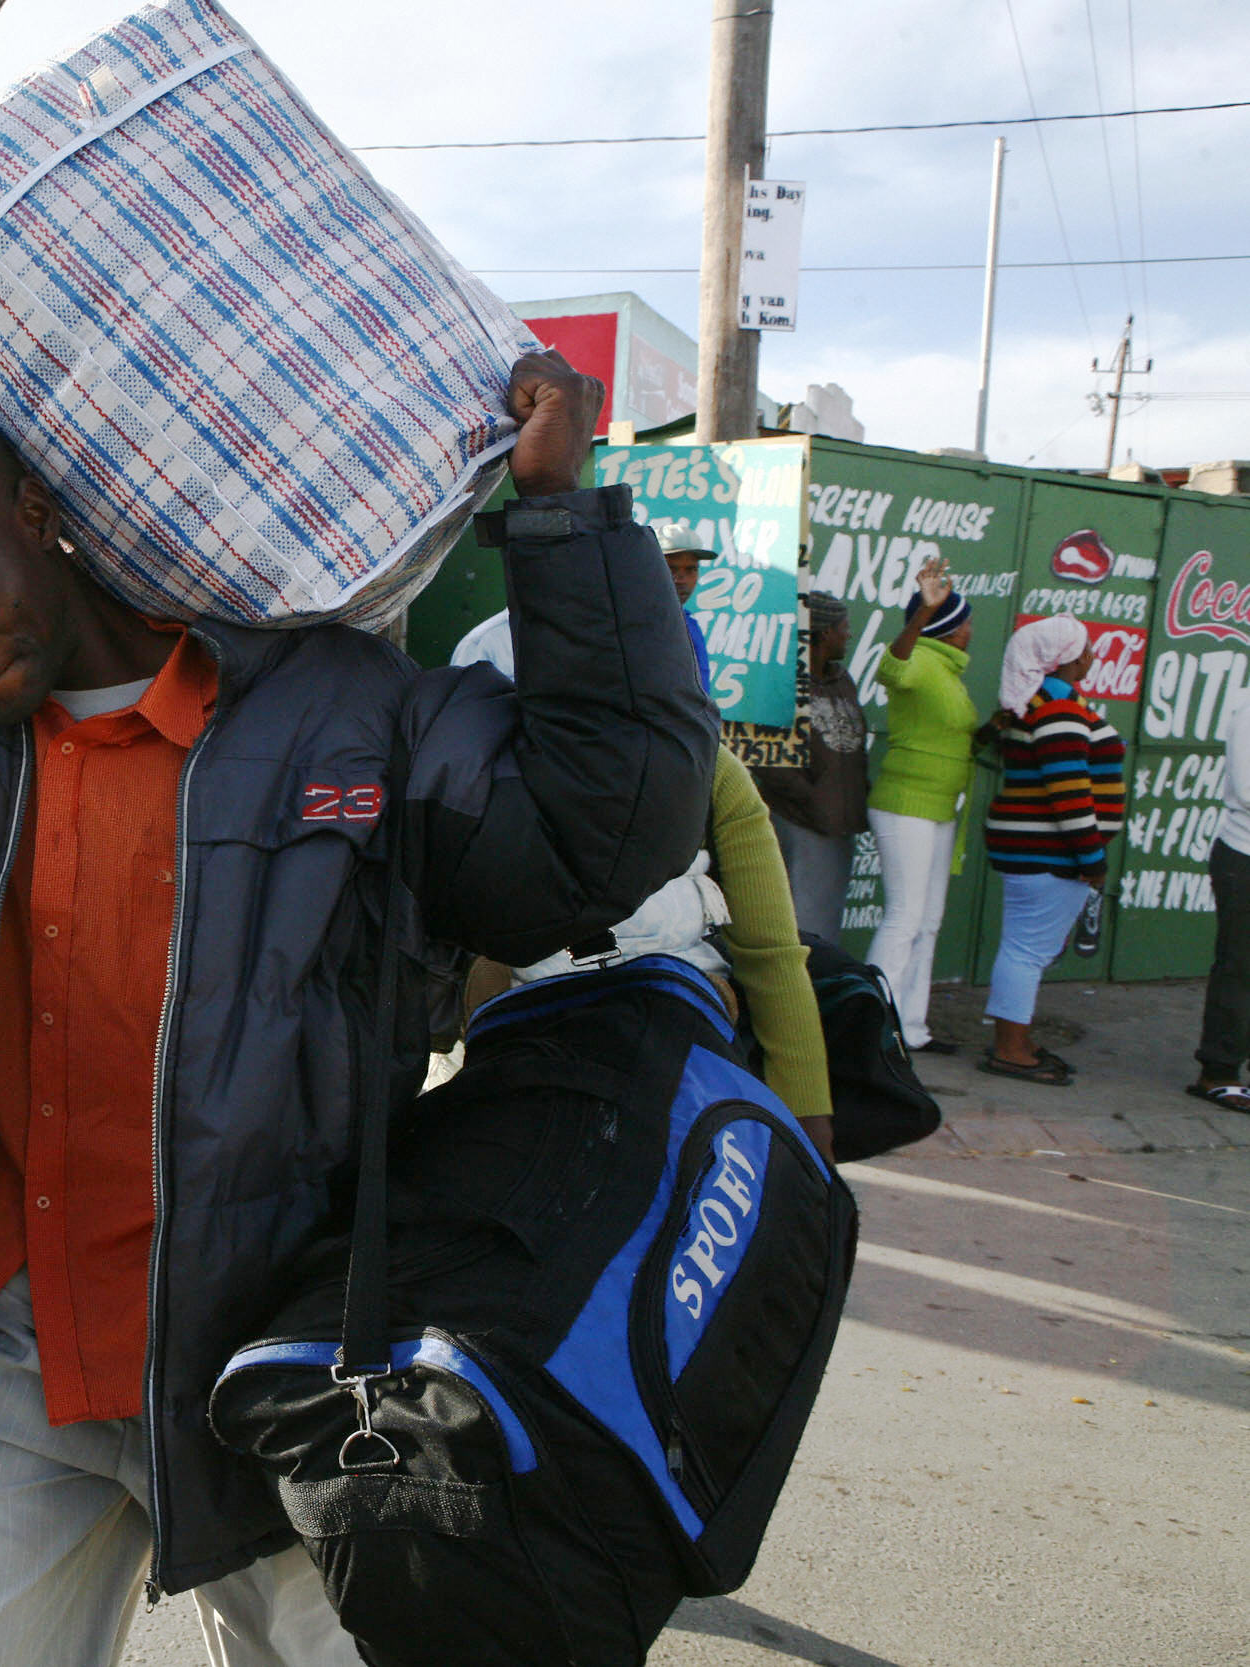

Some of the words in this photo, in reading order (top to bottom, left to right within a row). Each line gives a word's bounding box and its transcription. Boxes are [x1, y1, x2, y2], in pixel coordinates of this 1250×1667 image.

[902, 496, 994, 541] HOUSE
[696, 567, 764, 613] 20
[302, 784, 383, 821] 23
[672, 1130, 757, 1320] SPORT
